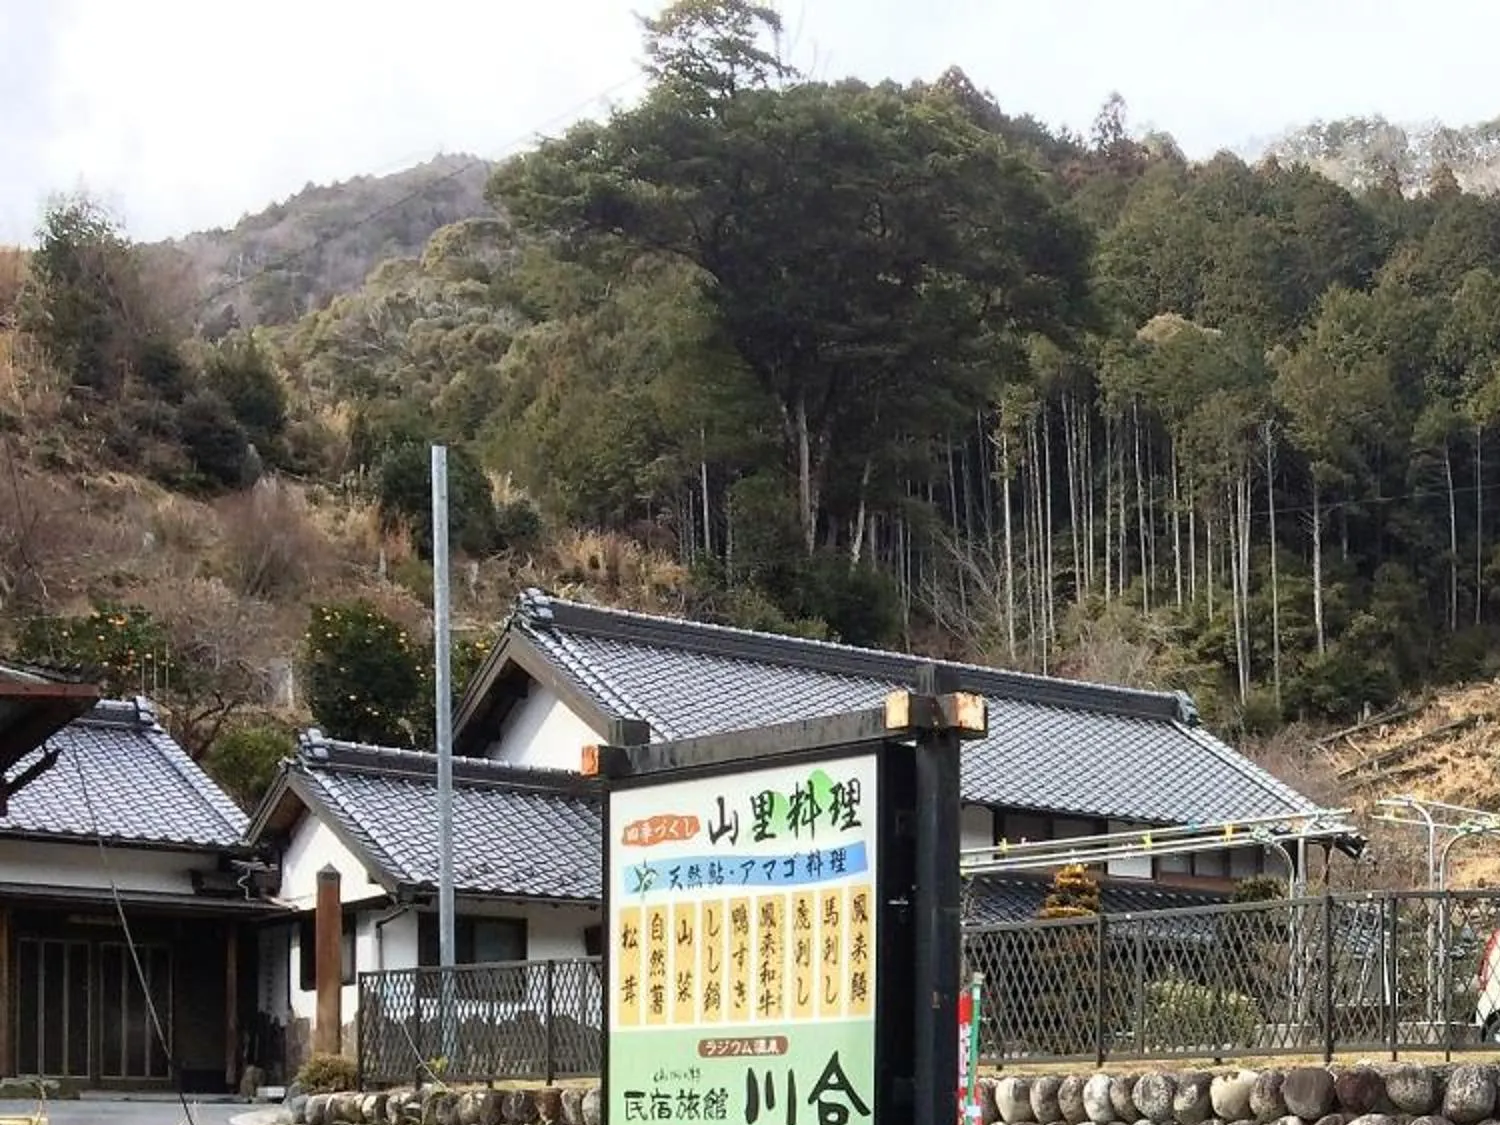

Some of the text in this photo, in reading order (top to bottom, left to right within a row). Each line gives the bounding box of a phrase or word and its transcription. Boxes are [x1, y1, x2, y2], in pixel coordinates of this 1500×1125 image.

[708, 777, 863, 846] 山里料理
[823, 896, 840, 1005] 馬刺し
[704, 1038, 781, 1057] ラジウム温泉
[623, 1086, 729, 1122] 民宿旅館
